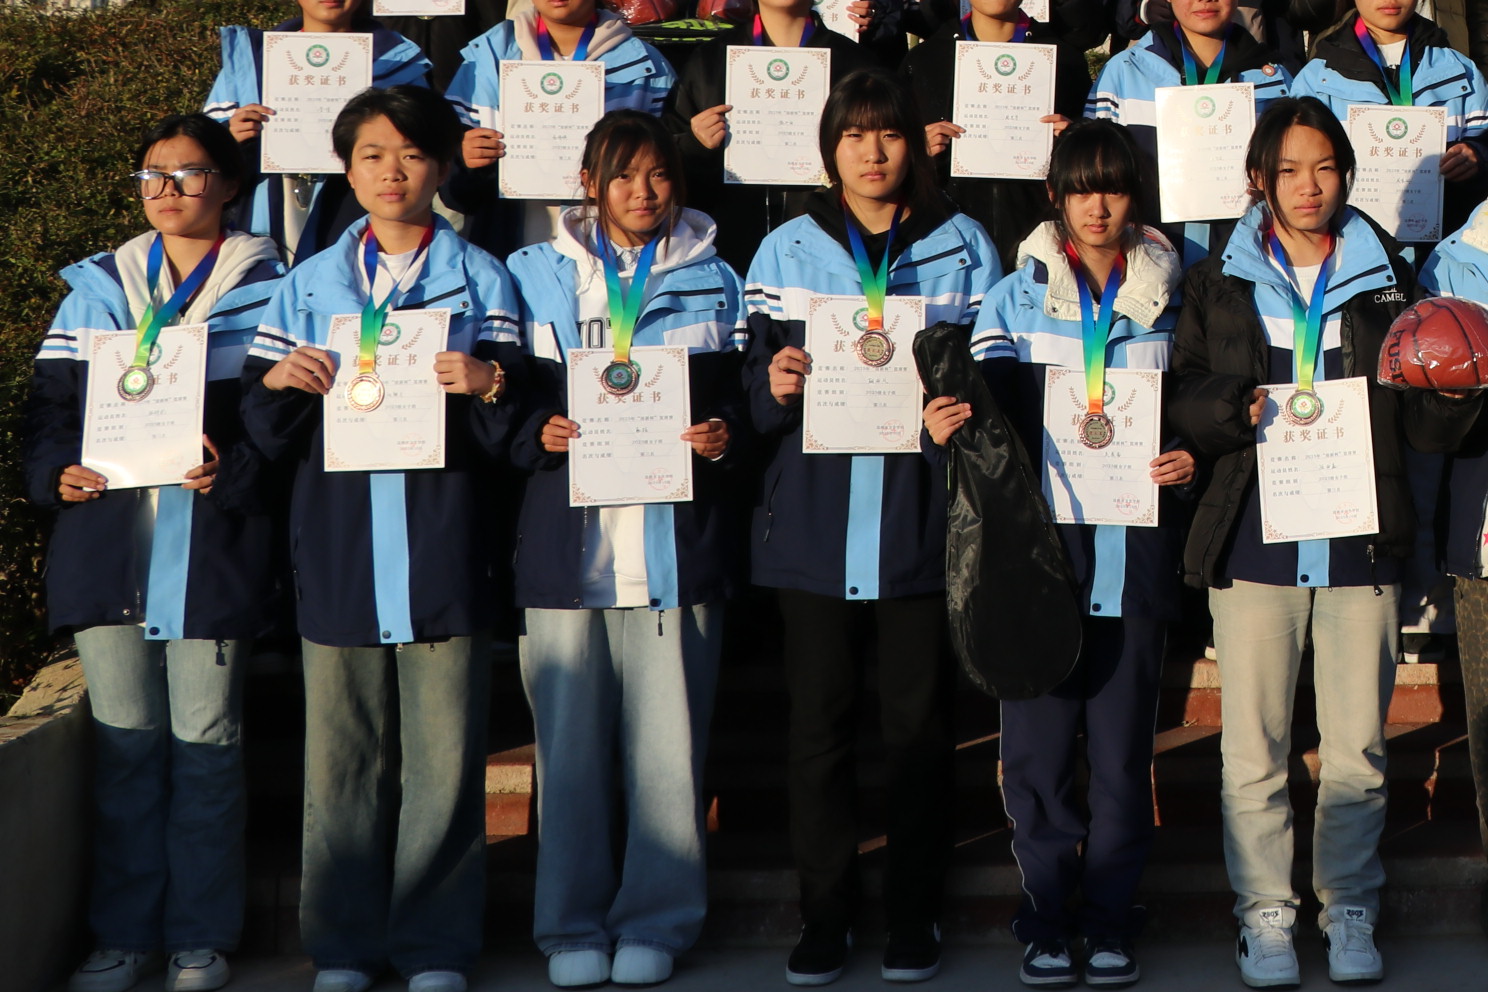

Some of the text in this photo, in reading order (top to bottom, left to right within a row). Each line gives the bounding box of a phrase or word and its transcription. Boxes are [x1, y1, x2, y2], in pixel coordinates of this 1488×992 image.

[289, 74, 346, 86] 获奖证书
[750, 88, 805, 100] 获奖证书
[978, 82, 1031, 95] 获奖证书
[524, 102, 580, 114] 获奖证书
[1370, 146, 1423, 158] 获奖证书
[1374, 292, 1406, 303] CAMEL
[597, 391, 661, 404] 获奖证书
[1283, 426, 1345, 443] 获奖证书
